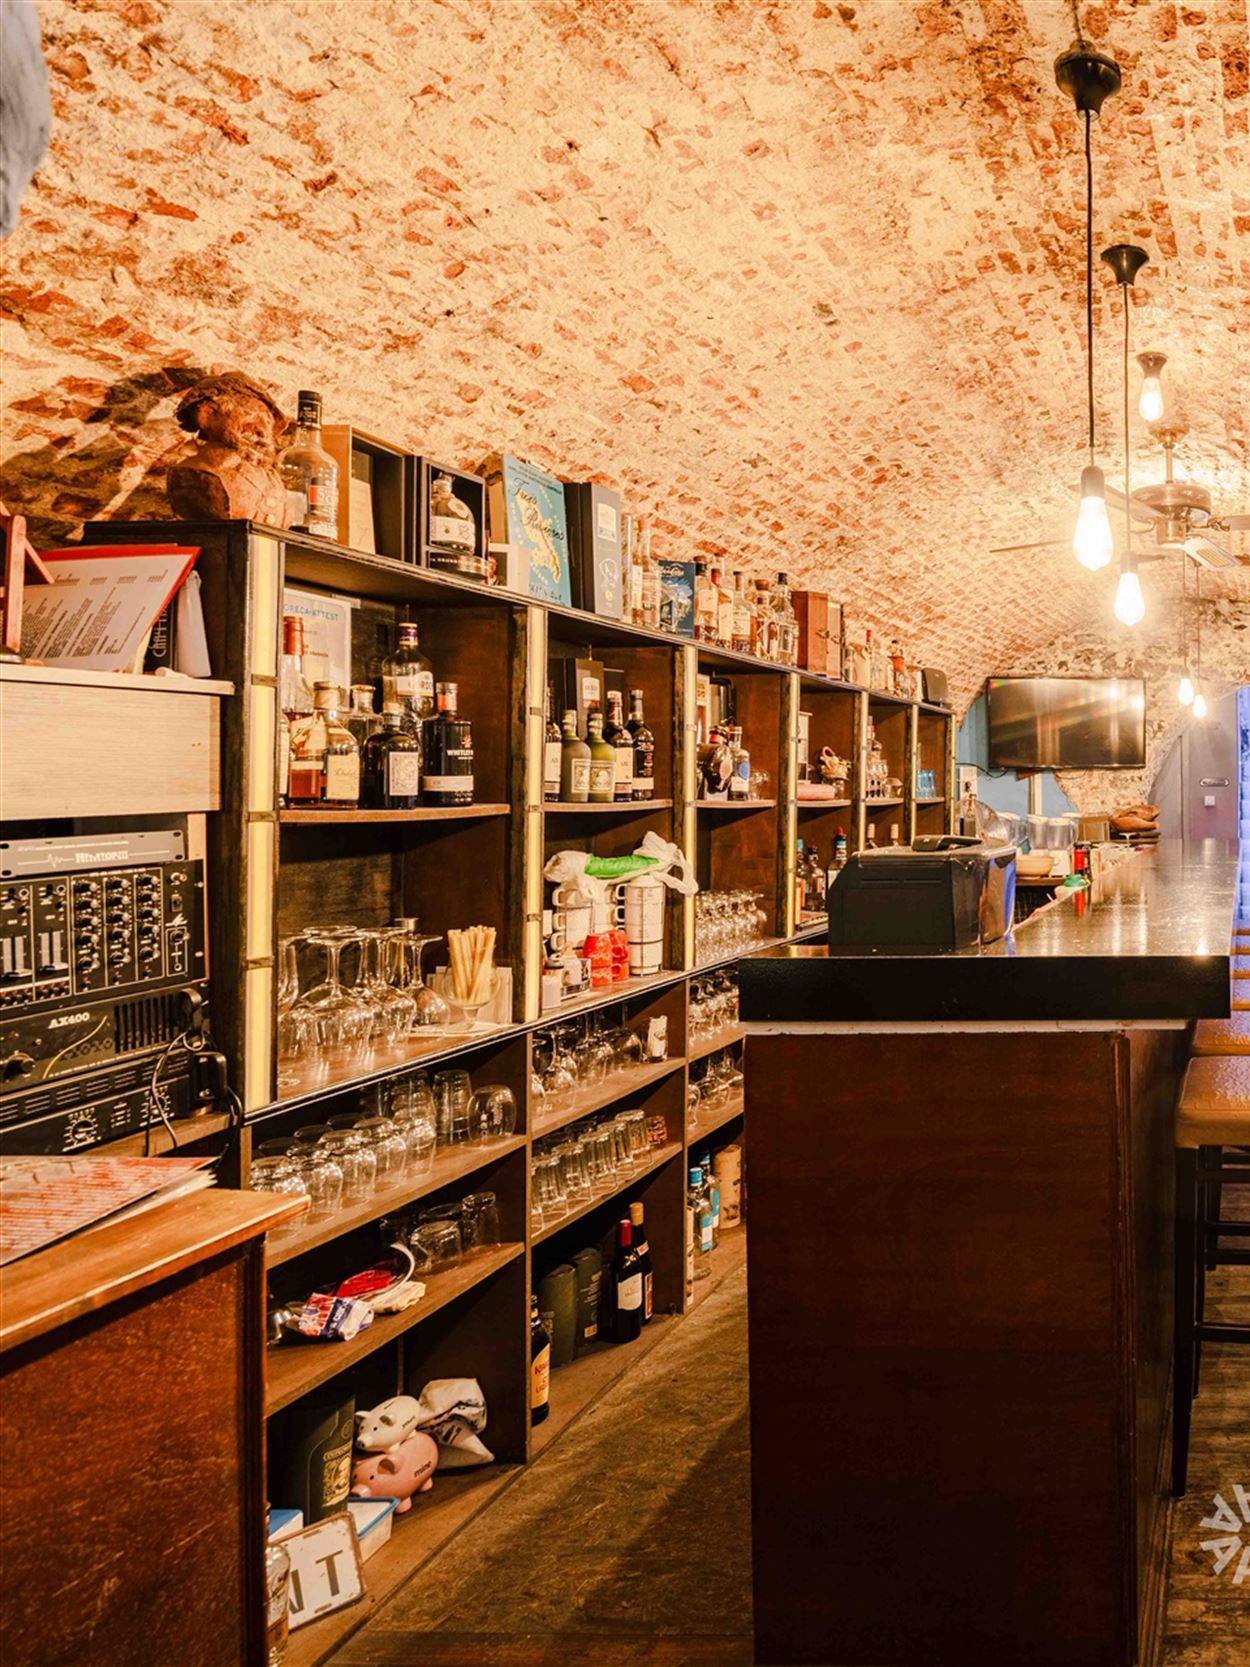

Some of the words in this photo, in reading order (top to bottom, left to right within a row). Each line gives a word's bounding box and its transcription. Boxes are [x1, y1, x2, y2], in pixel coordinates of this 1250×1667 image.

[284, 604, 338, 621] ORECA-ATTEST
[48, 1012, 91, 1029] AX400
[414, 1461, 432, 1478] mine
